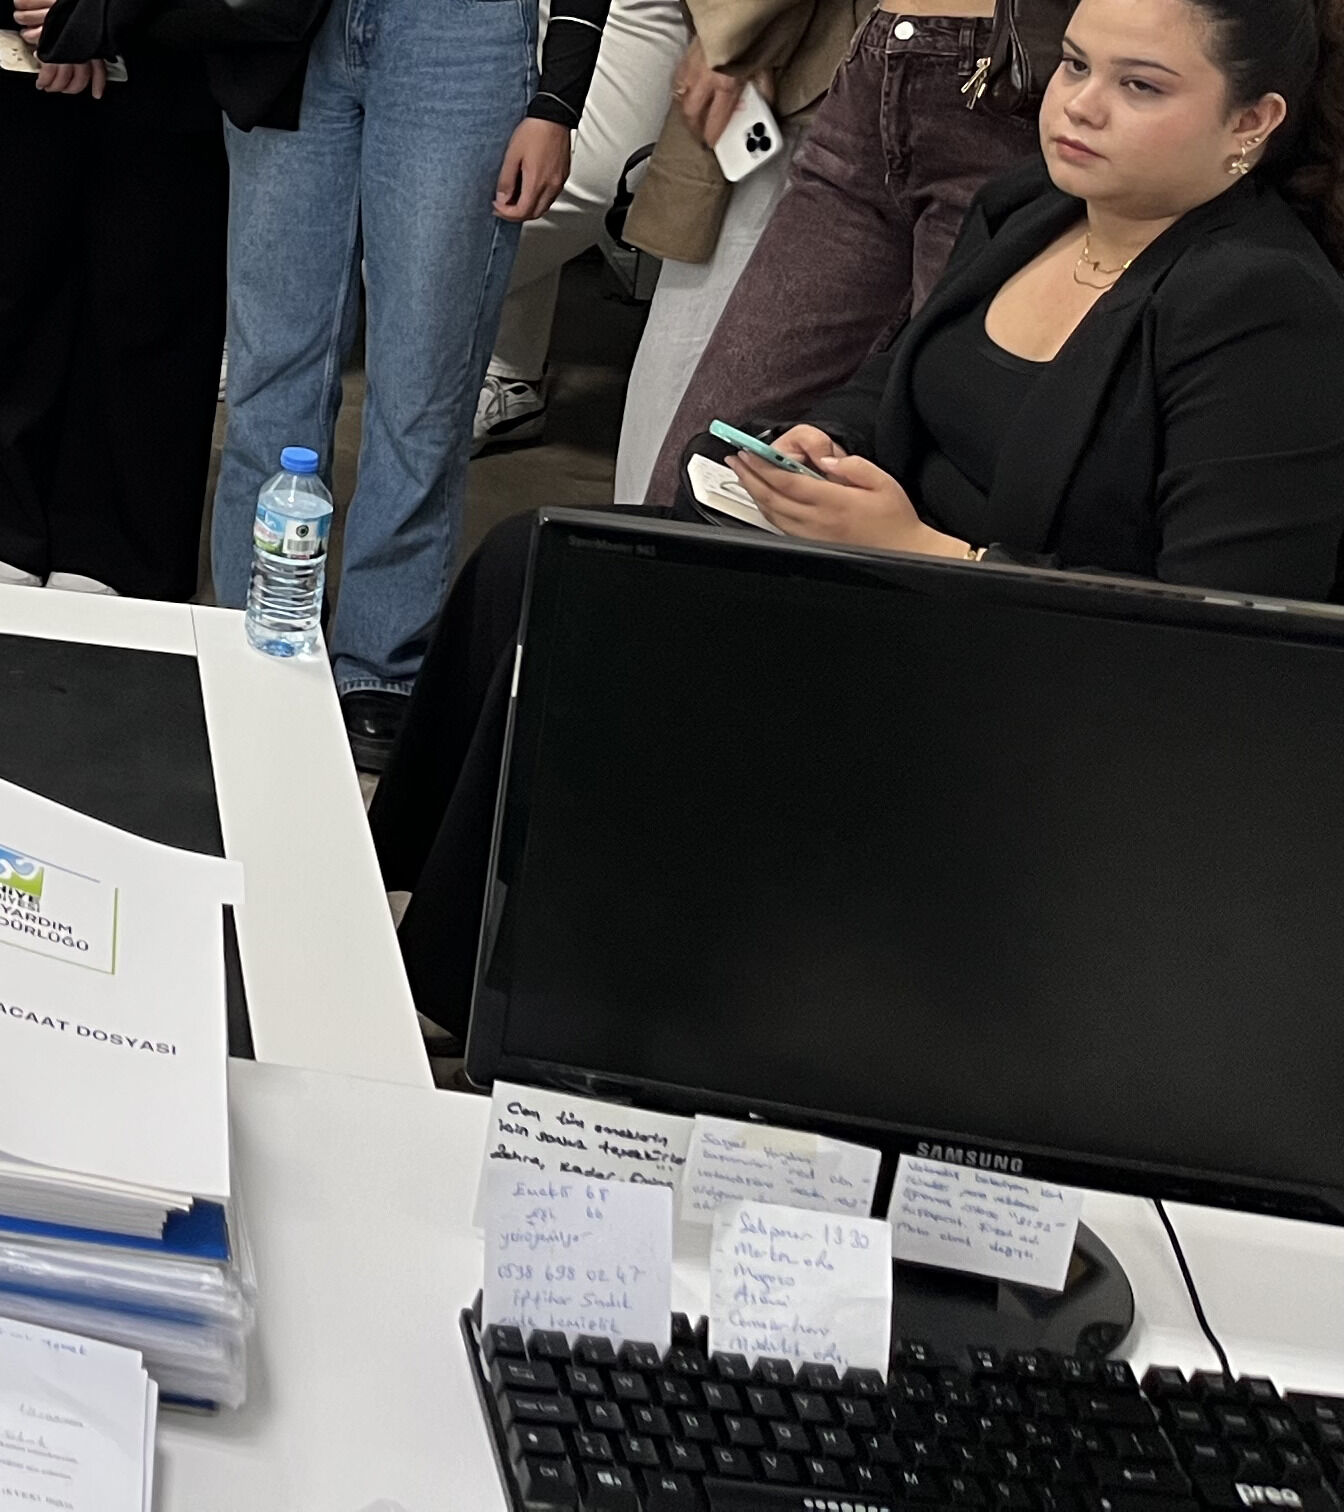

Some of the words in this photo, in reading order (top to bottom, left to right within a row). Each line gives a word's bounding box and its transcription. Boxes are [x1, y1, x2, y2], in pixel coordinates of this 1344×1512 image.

[1, 904, 73, 935] YARDIM
[76, 1025, 178, 1055] DOSYASI
[916, 1141, 1024, 1173] SAMSUNG
